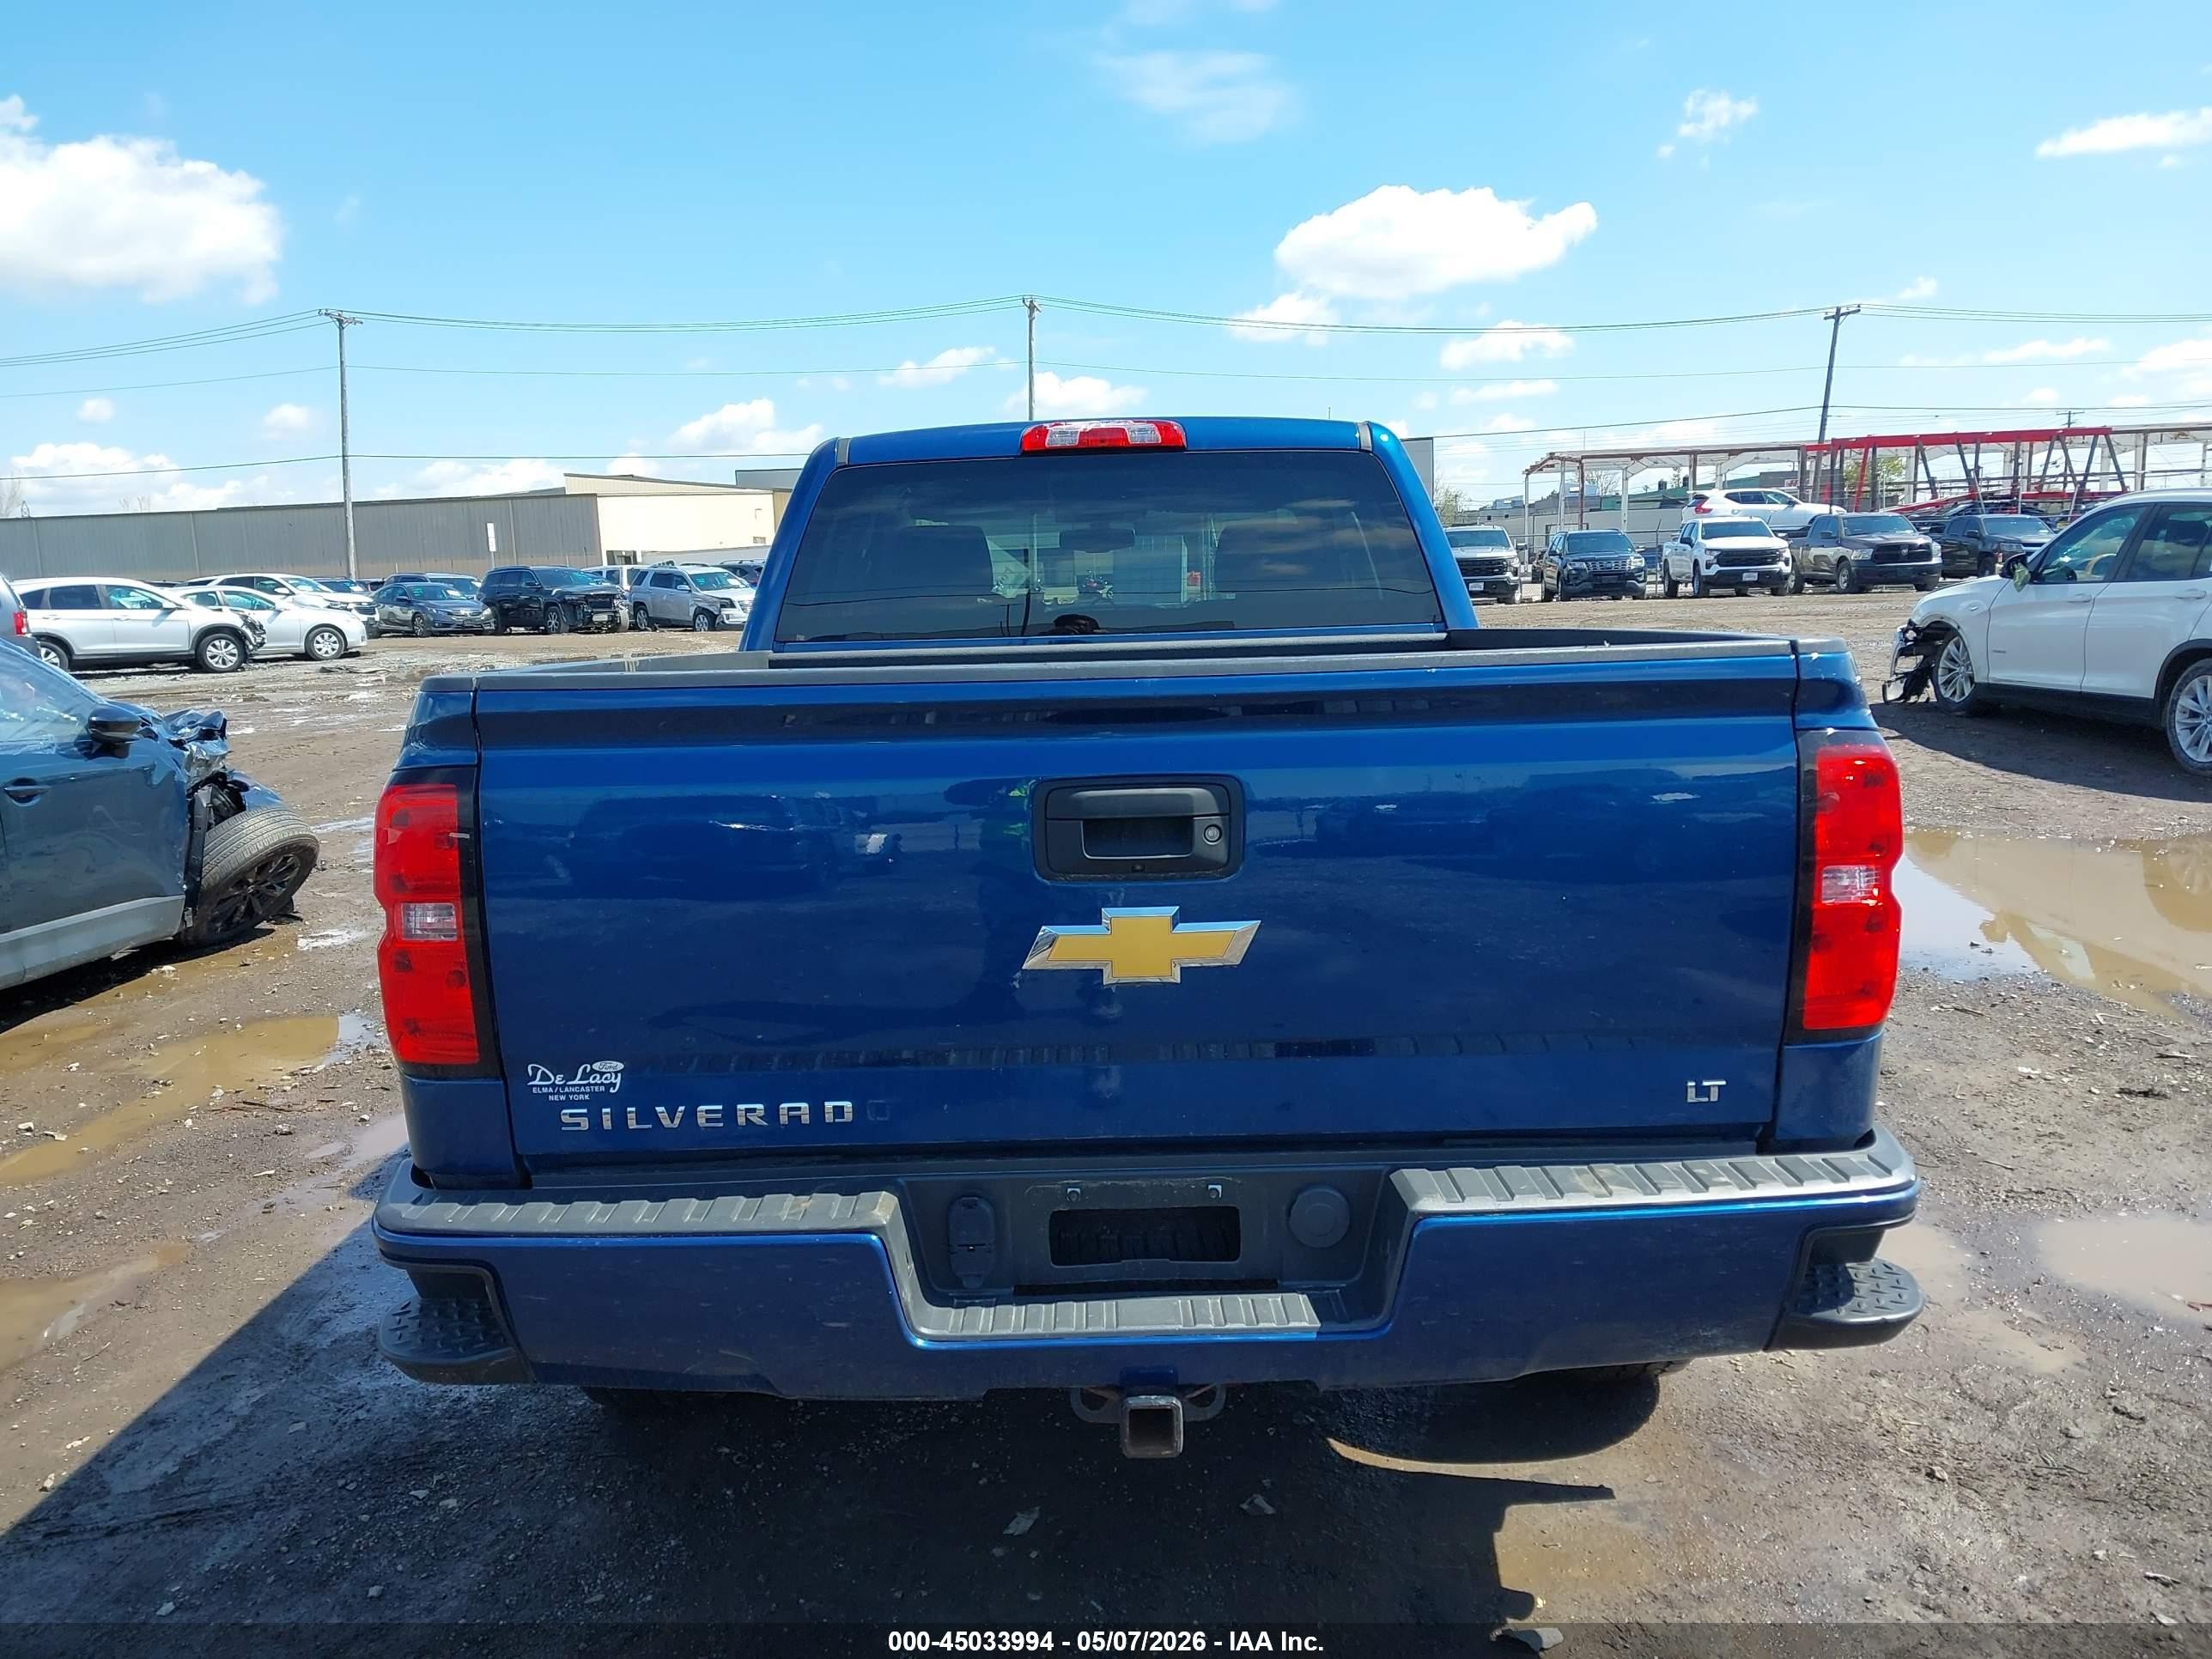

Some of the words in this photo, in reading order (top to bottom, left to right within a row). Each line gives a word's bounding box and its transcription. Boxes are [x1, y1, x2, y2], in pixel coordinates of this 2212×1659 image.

[527, 1064, 566, 1085] De
[567, 1064, 622, 1093] Lacy
[1687, 1079, 1726, 1103] LT
